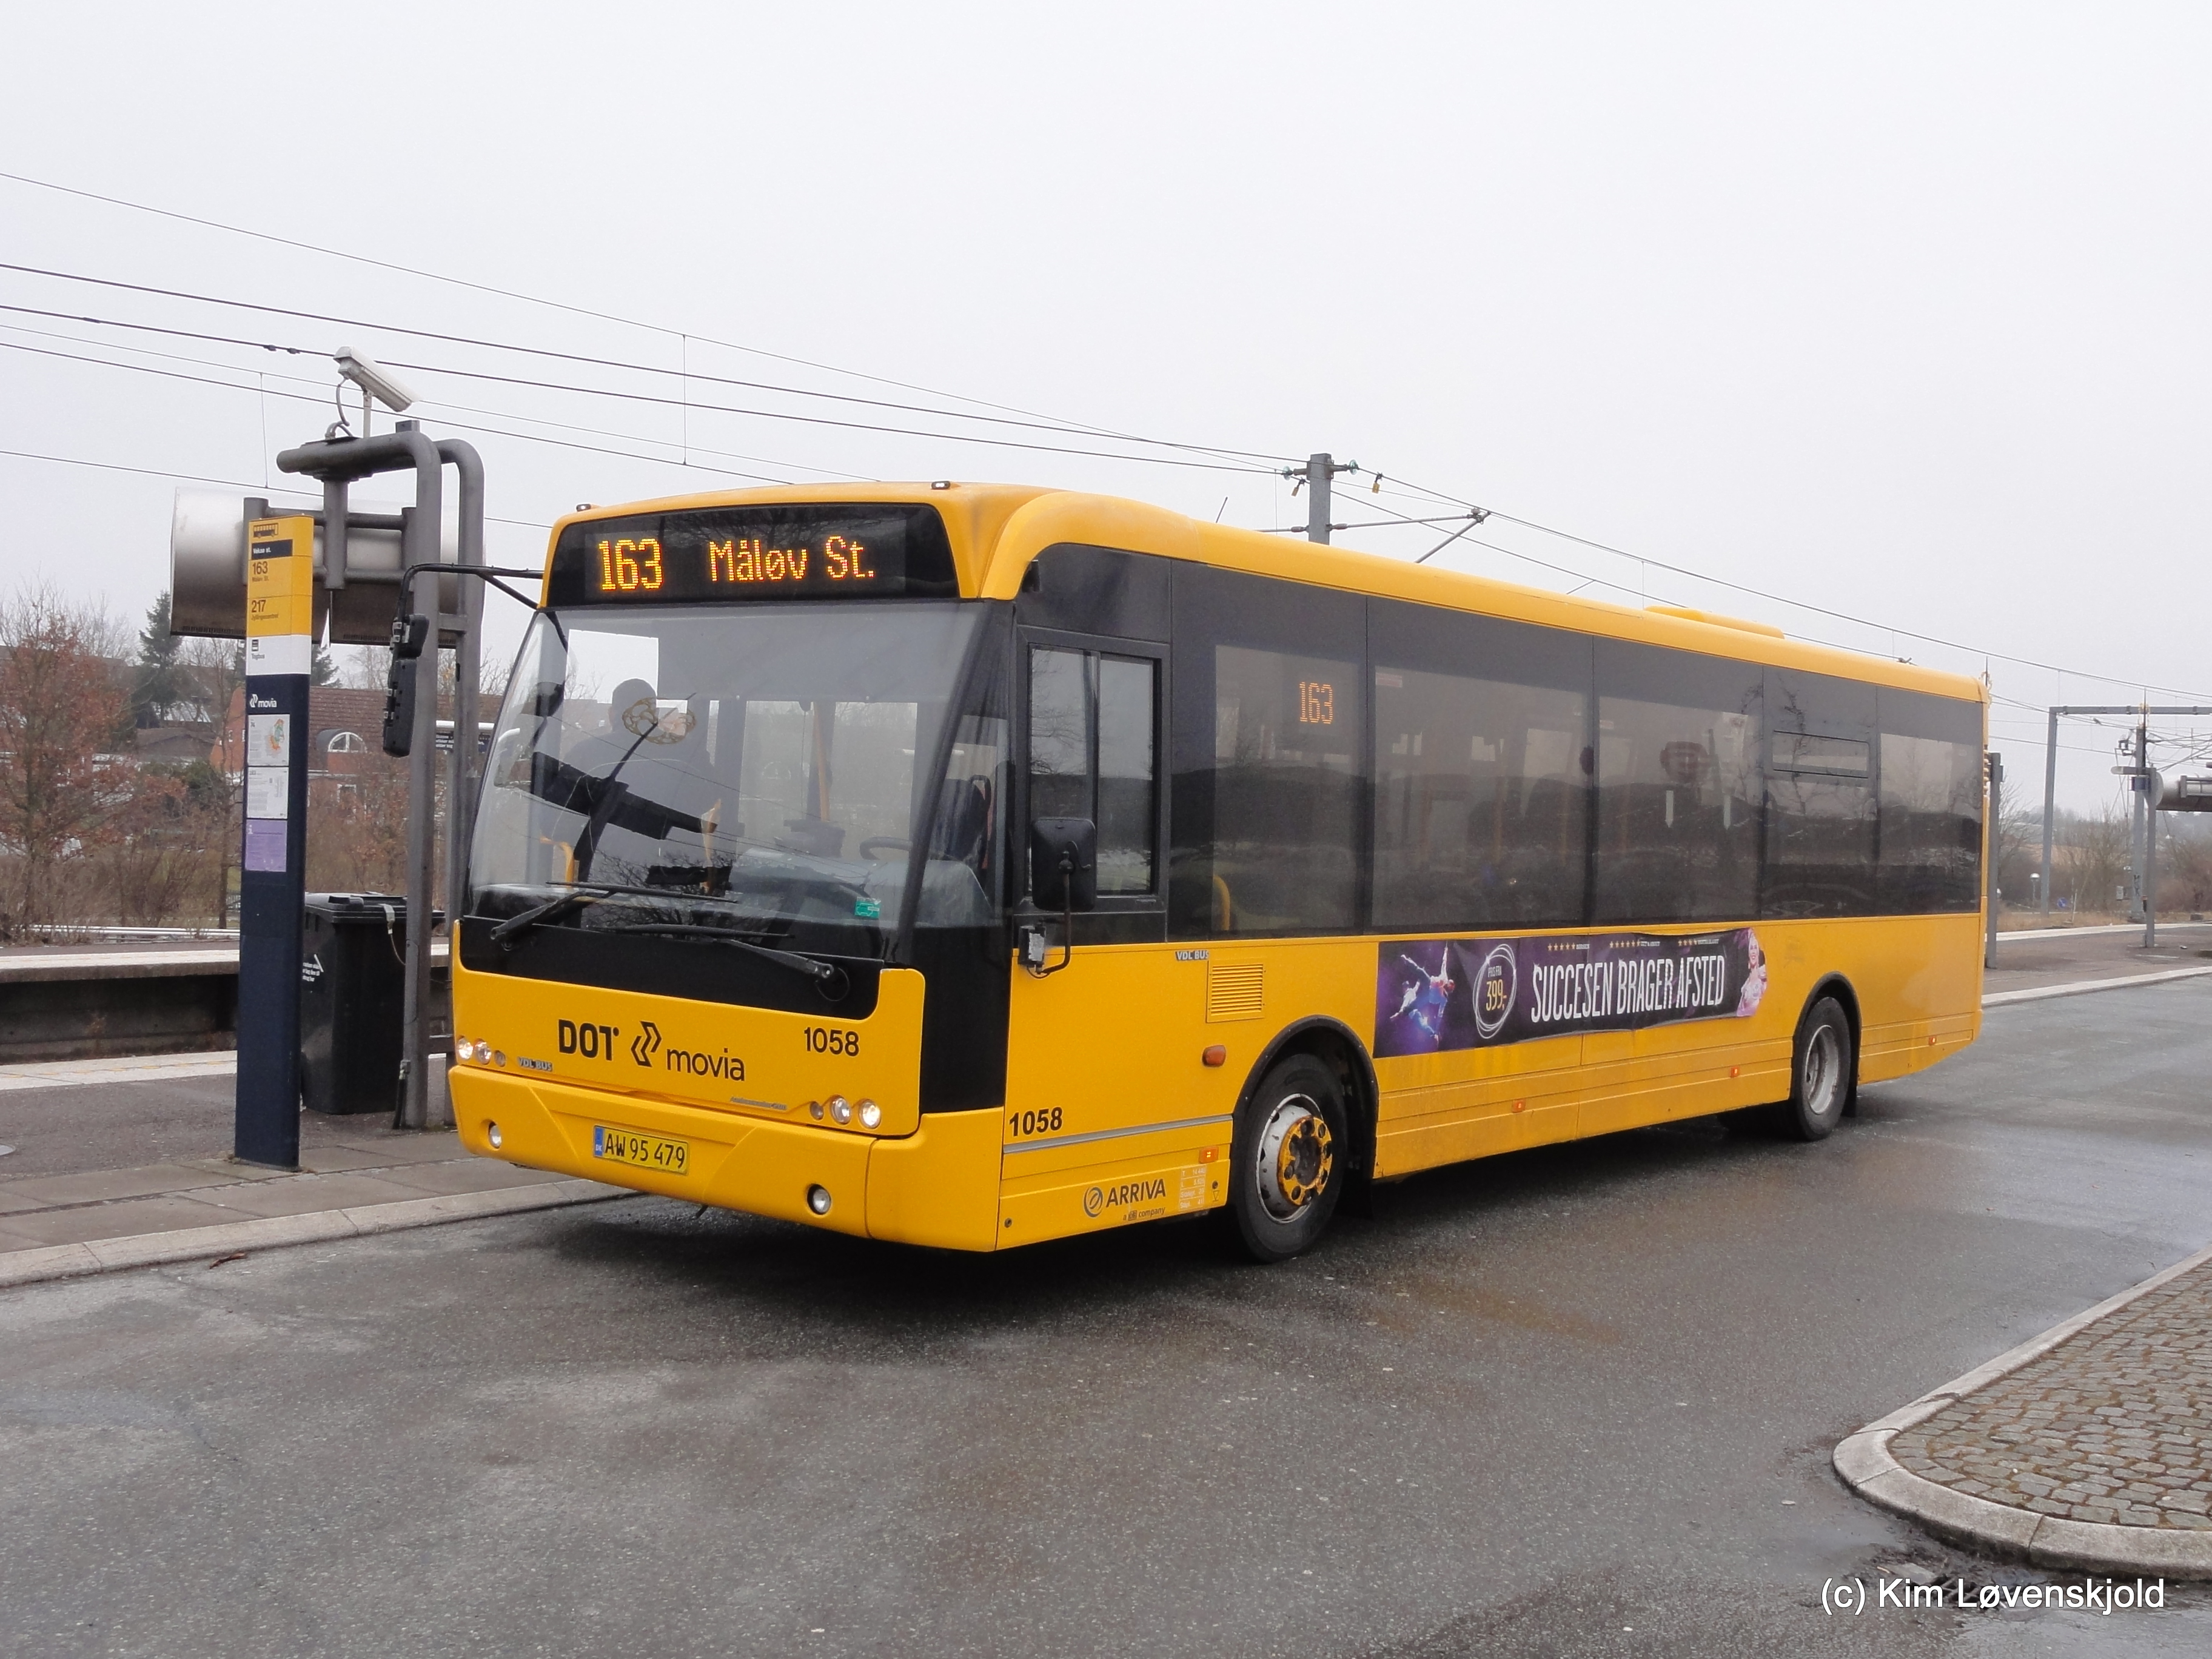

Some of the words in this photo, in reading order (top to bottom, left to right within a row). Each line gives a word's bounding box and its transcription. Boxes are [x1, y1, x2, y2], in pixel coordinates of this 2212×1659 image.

[252, 561, 268, 575] 163
[599, 538, 663, 591] 163
[708, 538, 808, 581] Måløv
[826, 535, 874, 579] St.
[252, 600, 266, 612] 217
[258, 698, 277, 708] movia
[1299, 682, 1333, 724] 163
[1177, 951, 1193, 960] VDL
[1195, 950, 1209, 959] BUS
[1530, 964, 1612, 1023] SUCCESEN
[1615, 959, 1674, 1016] BRAGER
[1676, 955, 1725, 1008] AFSTED
[558, 1019, 619, 1061] DOT
[667, 1048, 745, 1081] movia
[804, 1027, 859, 1057] 1058
[517, 1057, 534, 1068] VDL
[535, 1061, 551, 1071] BUS
[1009, 1107, 1063, 1137] 1058
[605, 1133, 626, 1156] AW
[630, 1138, 649, 1161] 95
[654, 1143, 685, 1168] 479
[1106, 1178, 1166, 1208] ARRIVA
[1139, 1207, 1166, 1218] company
